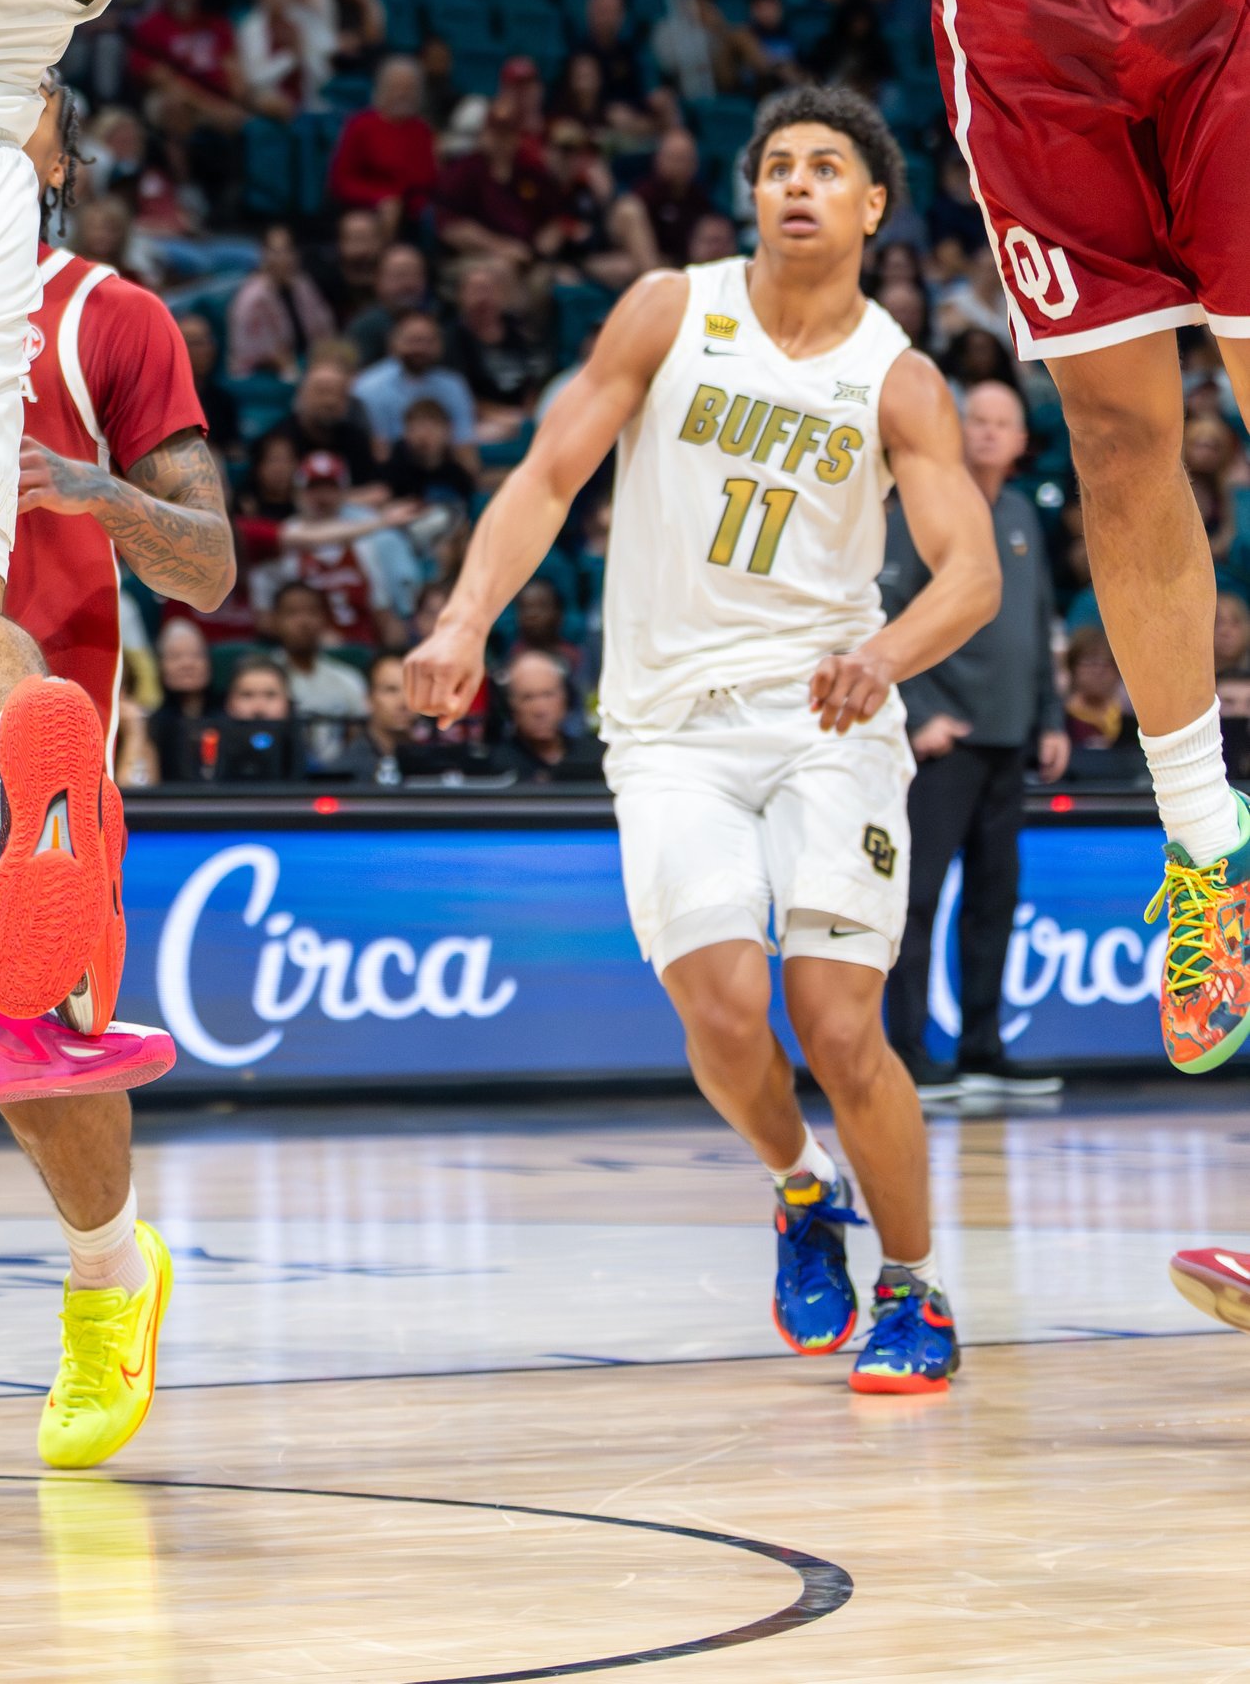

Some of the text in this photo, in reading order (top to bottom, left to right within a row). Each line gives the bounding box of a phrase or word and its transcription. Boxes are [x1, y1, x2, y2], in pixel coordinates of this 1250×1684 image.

[679, 383, 865, 485] BUFFS
[707, 478, 798, 576] 11
[156, 843, 517, 1068] Circa
[928, 857, 1170, 1043] irc
